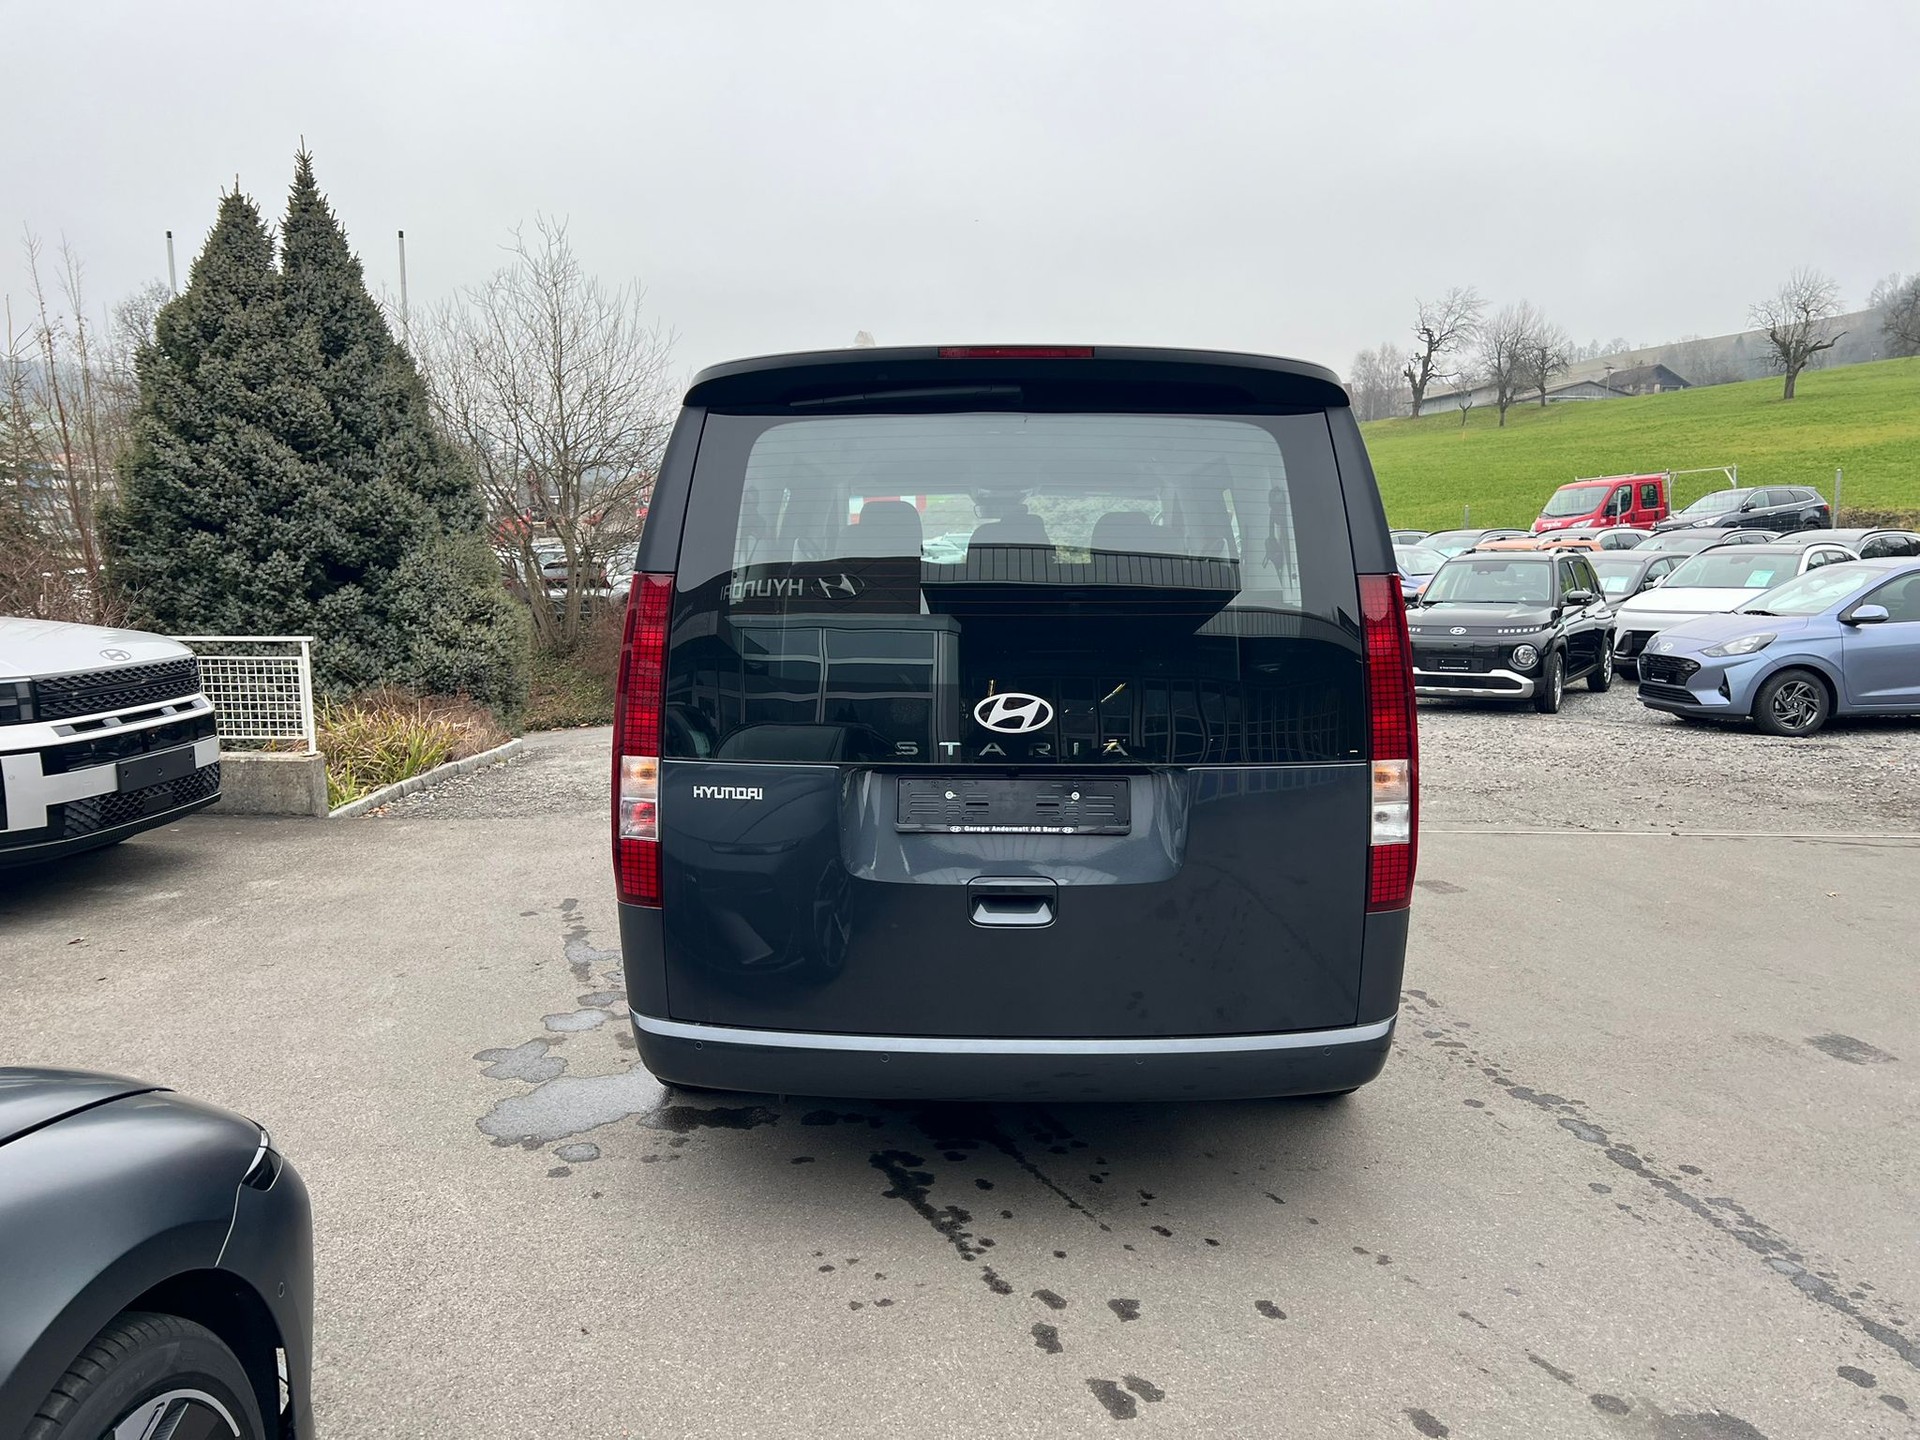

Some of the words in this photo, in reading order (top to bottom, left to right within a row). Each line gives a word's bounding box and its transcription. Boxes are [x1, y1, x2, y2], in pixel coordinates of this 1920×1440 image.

[895, 741, 1129, 756] STARIA
[693, 785, 763, 800] HYUNDAI
[964, 825, 990, 833] Garage
[991, 825, 1029, 833] Andermatt
